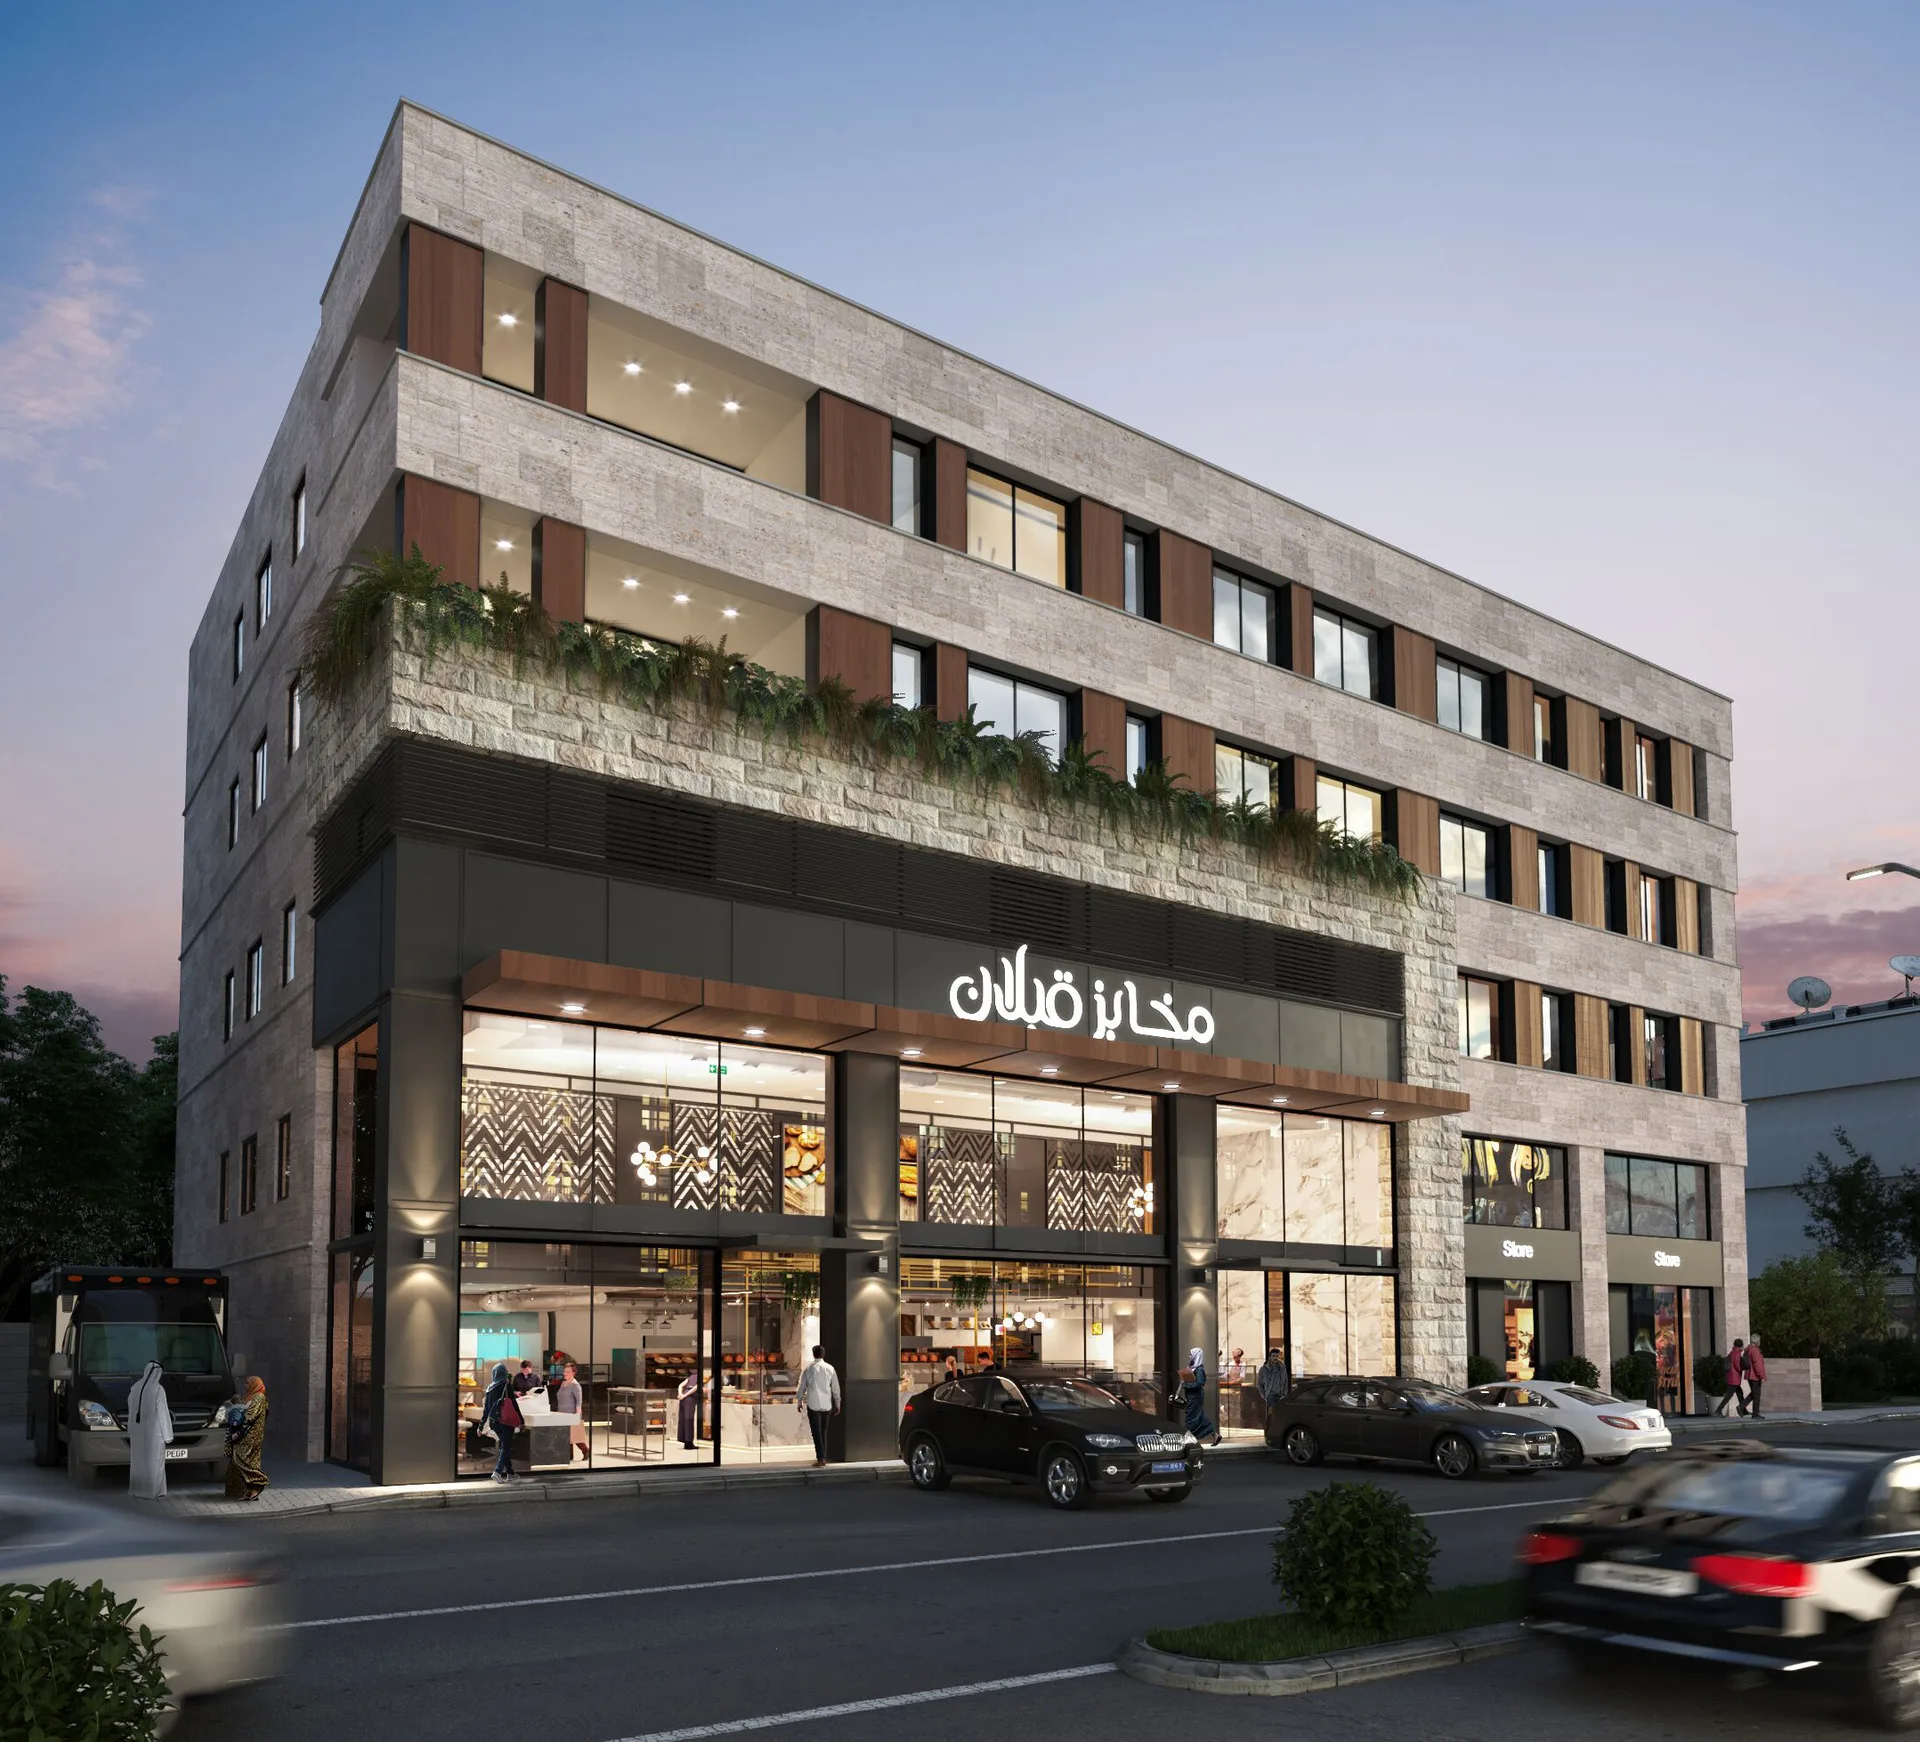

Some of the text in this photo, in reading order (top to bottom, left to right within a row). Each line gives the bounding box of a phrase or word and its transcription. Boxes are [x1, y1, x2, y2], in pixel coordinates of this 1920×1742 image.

[950, 944, 1214, 1044] مخابز قبلان
[1503, 1240, 1533, 1258] Store
[1655, 1251, 1680, 1267] Store
